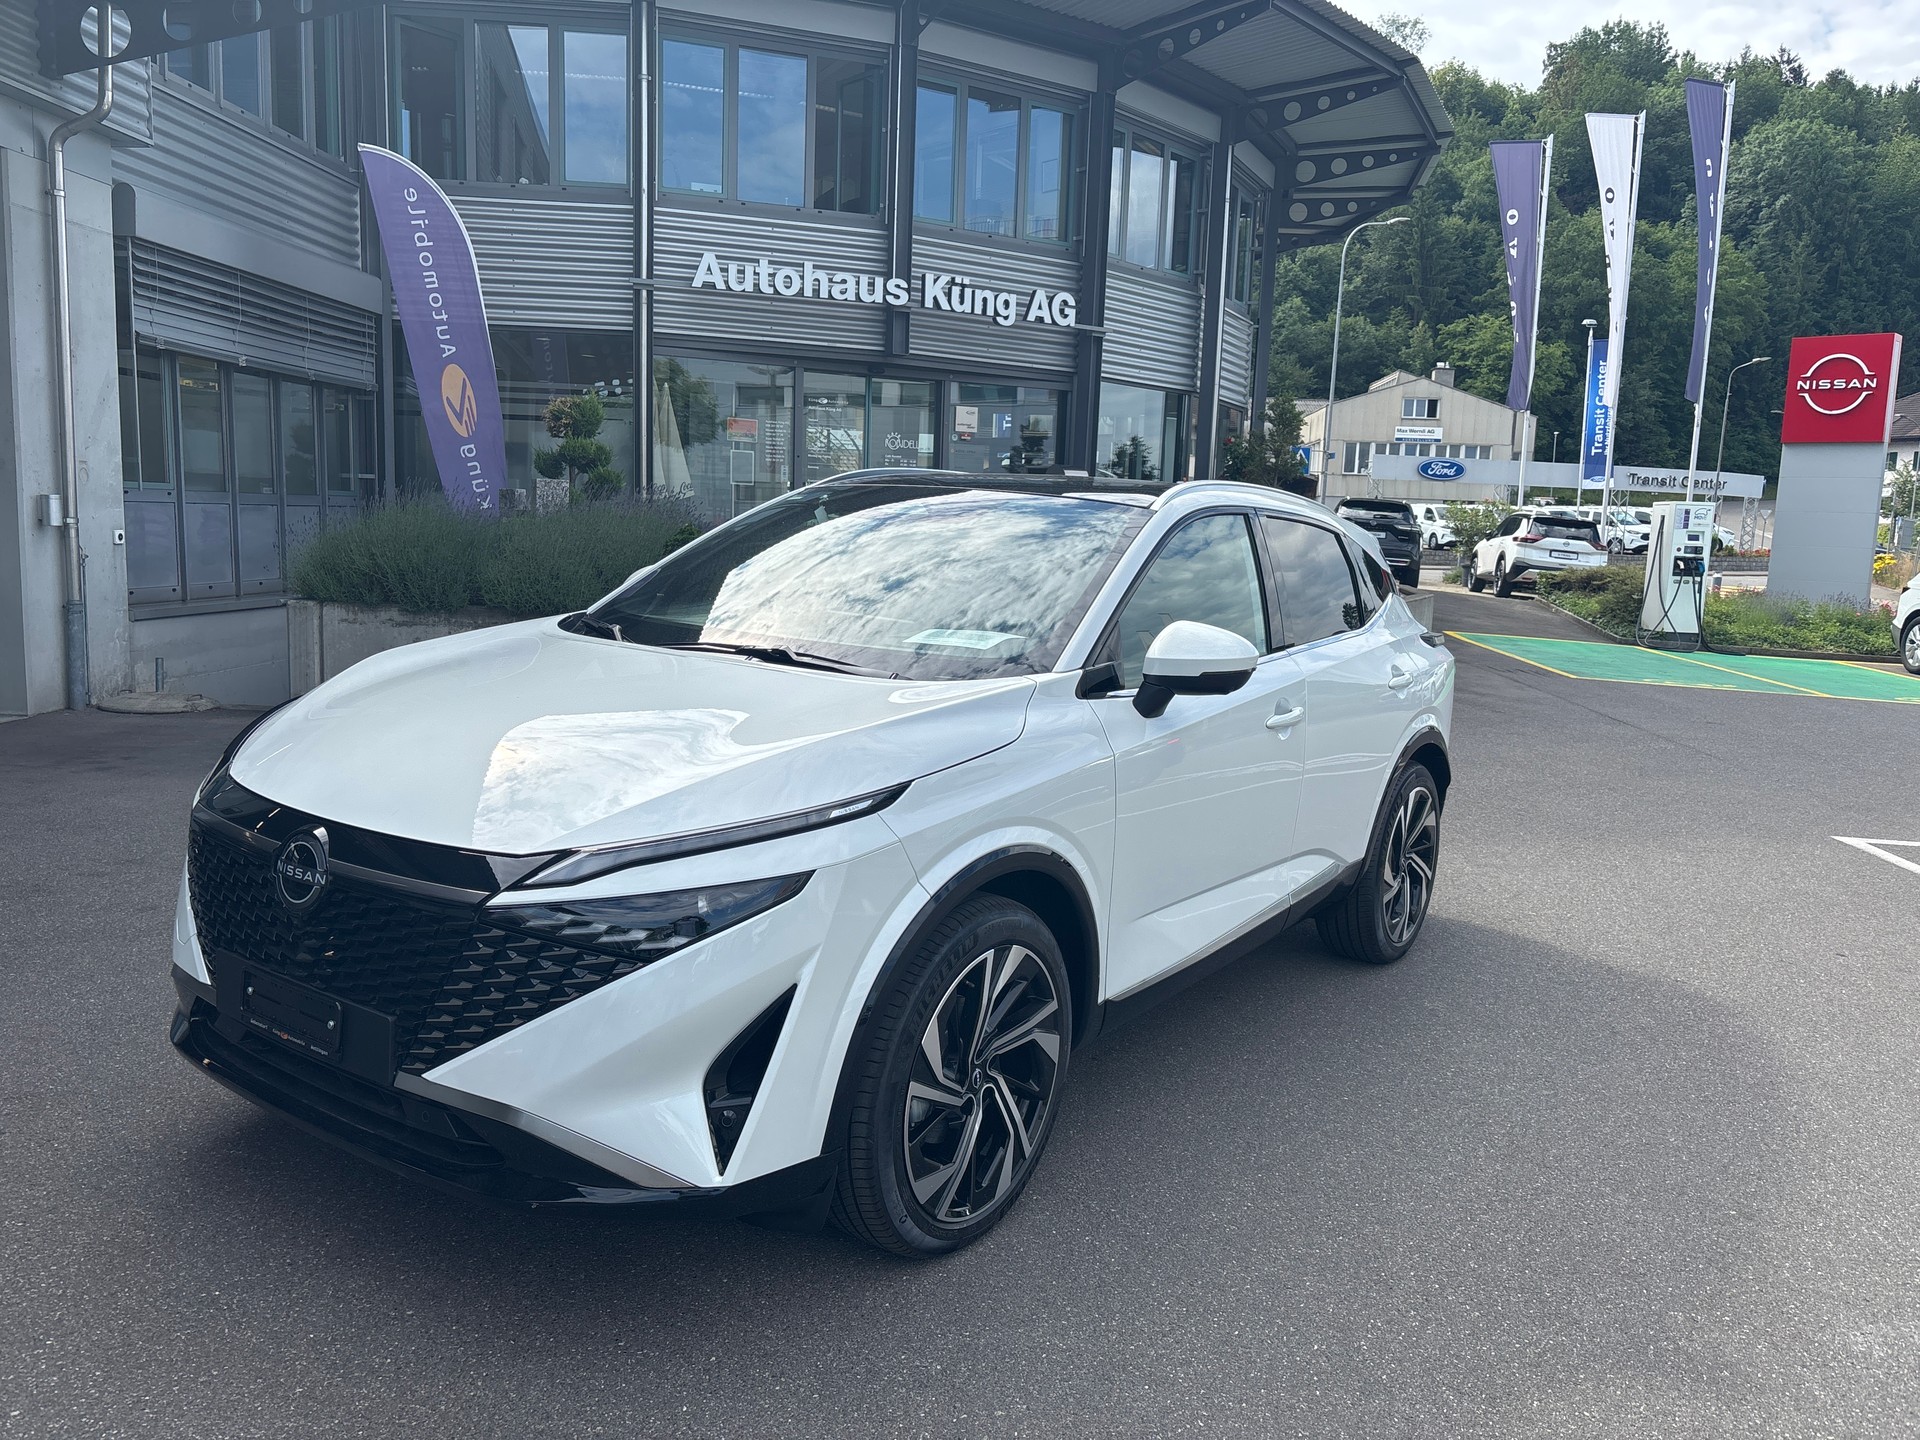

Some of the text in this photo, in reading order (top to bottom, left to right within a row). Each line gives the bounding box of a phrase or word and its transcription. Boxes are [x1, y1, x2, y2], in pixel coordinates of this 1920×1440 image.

[691, 251, 1076, 327] Autohaus Küng AG
[1796, 378, 1877, 390] NISSAN
[1590, 408, 1605, 457] Transit
[1427, 461, 1458, 476] Ford
[1628, 472, 1728, 490] Transit Center
[277, 859, 327, 886] NISSAN
[908, 934, 977, 1034] MICHELIN
